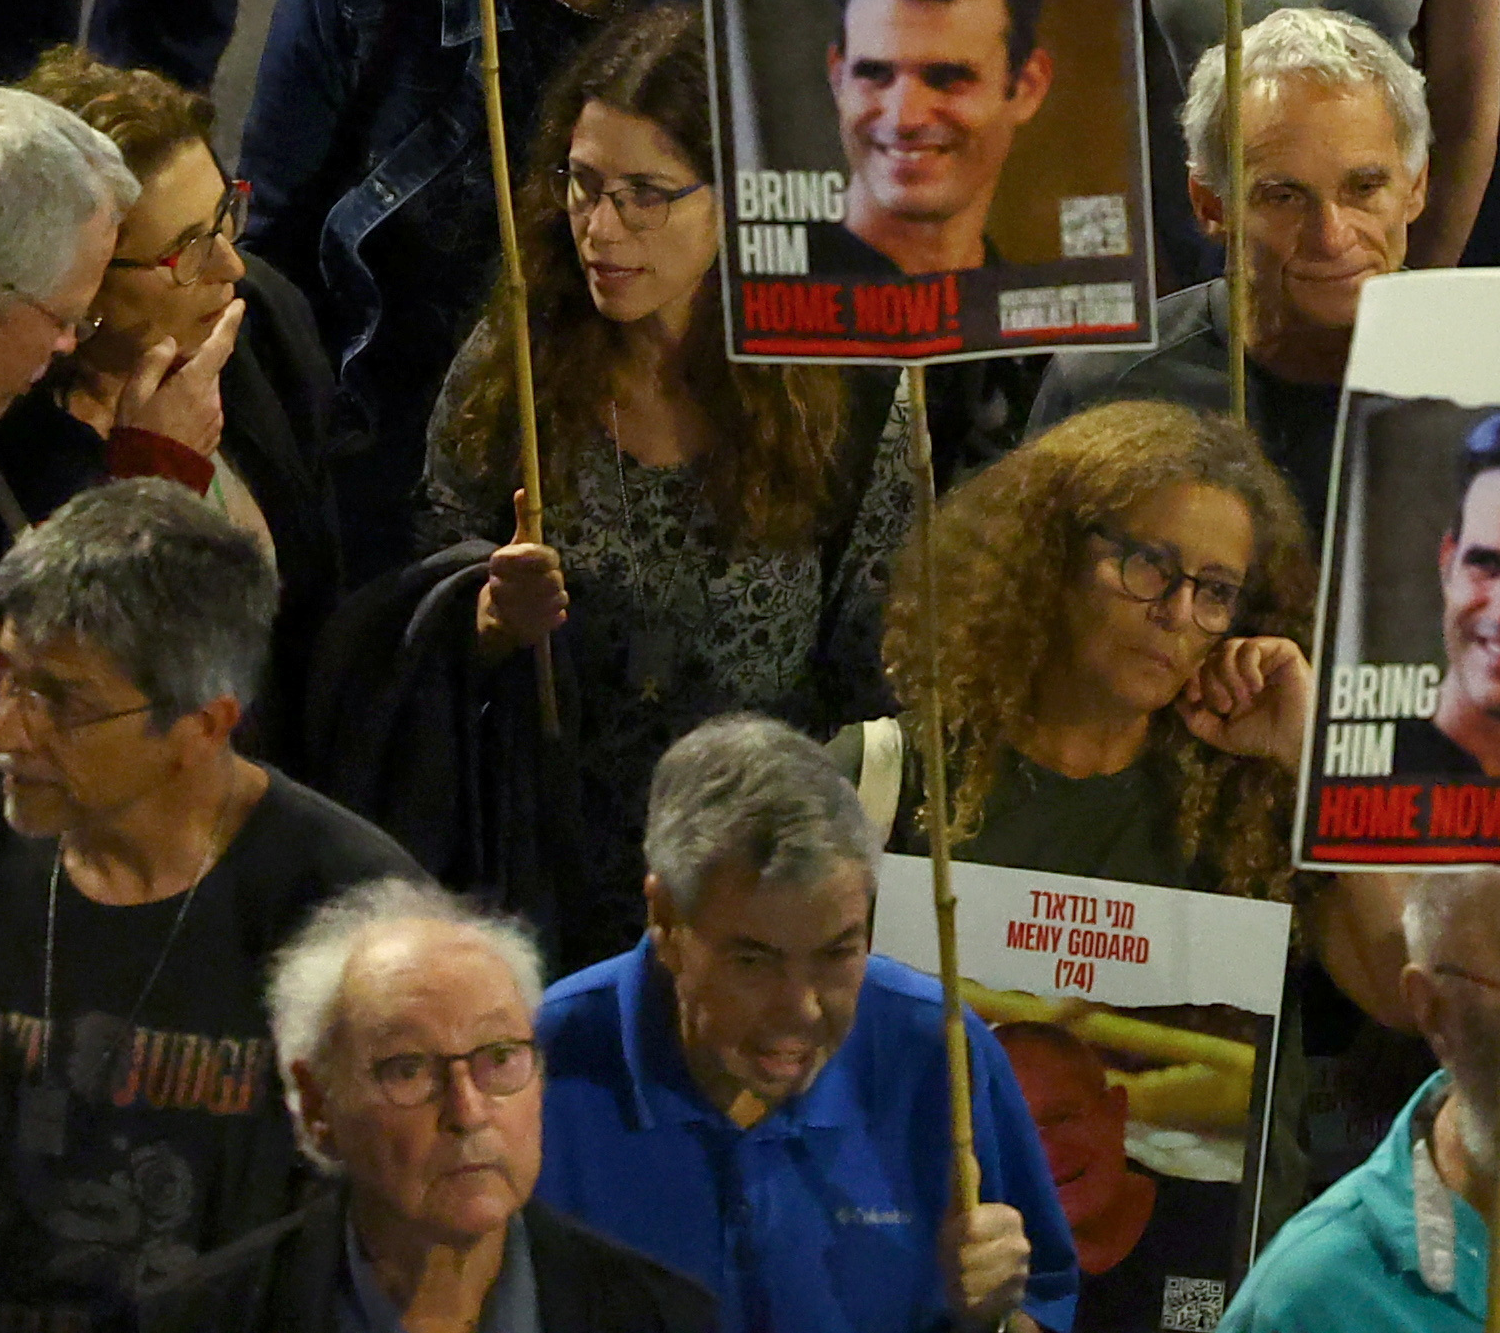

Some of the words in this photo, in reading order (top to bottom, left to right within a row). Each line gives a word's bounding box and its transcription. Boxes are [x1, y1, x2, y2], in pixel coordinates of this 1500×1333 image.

[735, 169, 845, 223] BRING
[737, 223, 810, 276] HIM
[743, 280, 846, 333] HOME
[854, 275, 961, 334] NOW!
[1328, 664, 1441, 720] BRING
[1323, 722, 1397, 778] HIM
[1318, 785, 1423, 839] HOME
[1031, 890, 1097, 925] גודארד
[1107, 901, 1135, 930] מני
[1006, 921, 1061, 953] MENY
[1068, 929, 1150, 964] GODARD
[1055, 959, 1094, 993] (74)
